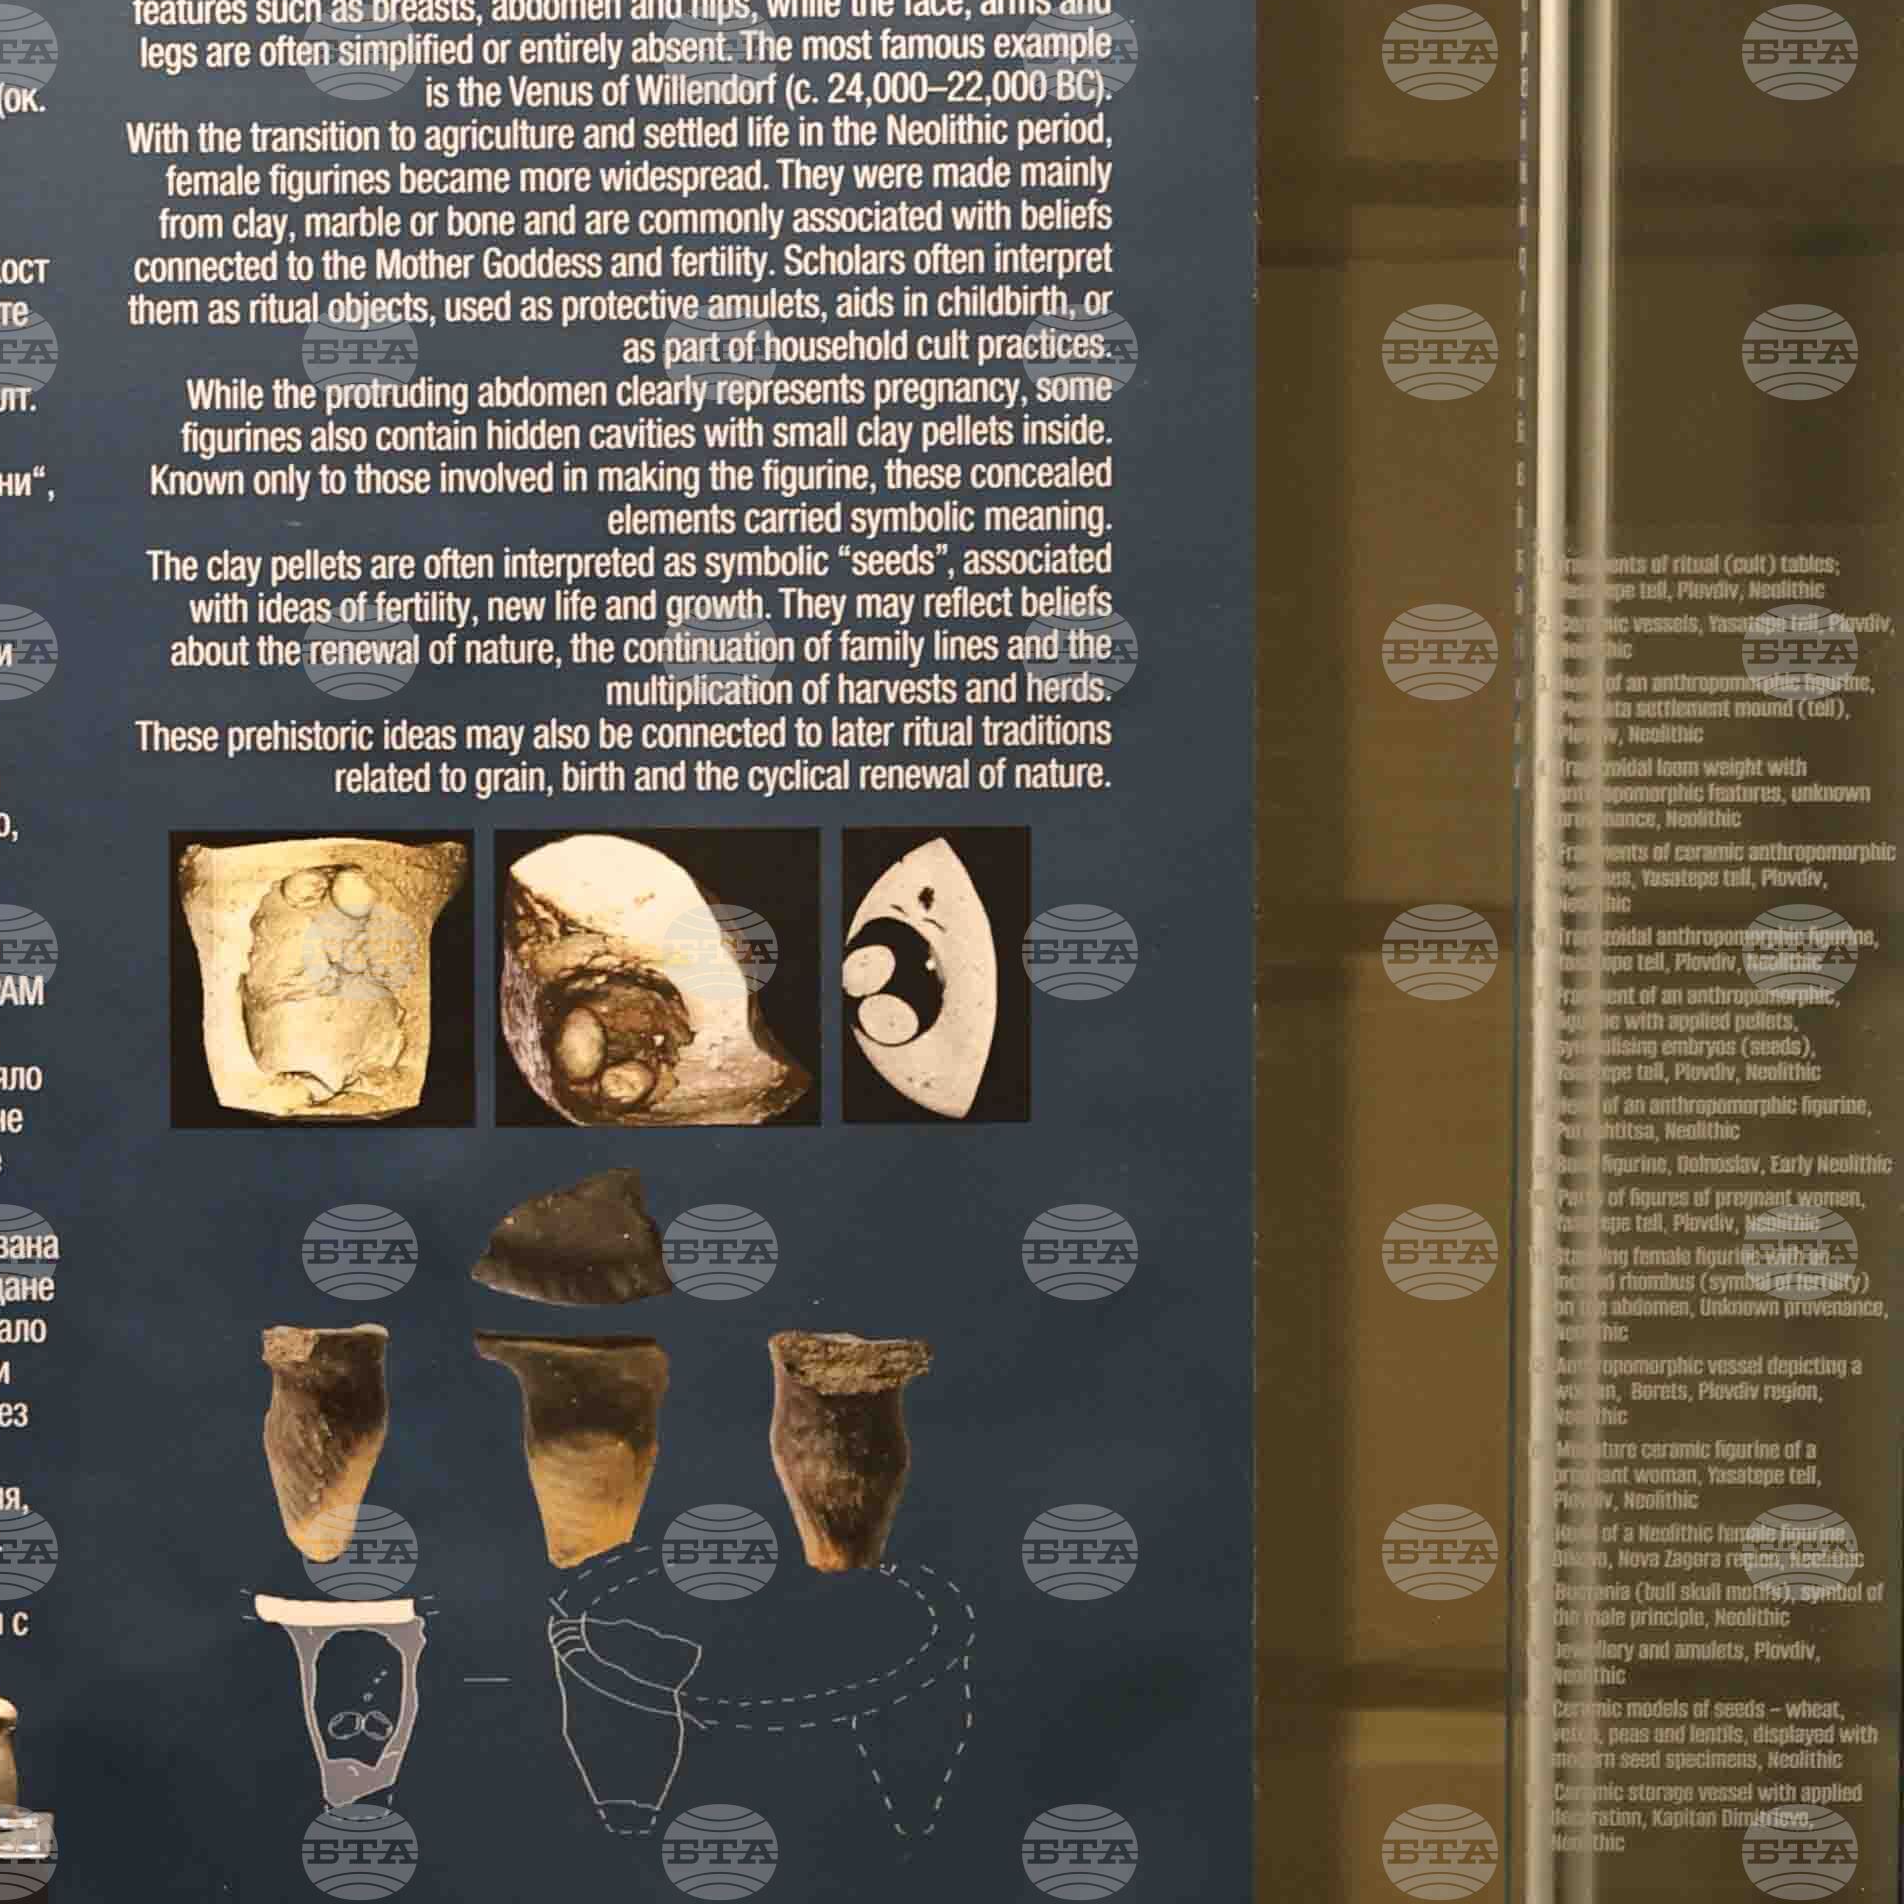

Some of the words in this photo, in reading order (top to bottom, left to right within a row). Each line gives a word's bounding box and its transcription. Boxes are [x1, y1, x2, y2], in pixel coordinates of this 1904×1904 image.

[335, 761, 431, 794] related
[438, 761, 467, 793] to
[475, 760, 554, 800] grain,
[562, 759, 626, 793] birth
[634, 759, 686, 792] and
[693, 759, 740, 792] the
[747, 758, 850, 798] cyclical
[859, 757, 970, 791] renewal
[978, 756, 1007, 790] of
[1015, 757, 1112, 789] nature.
